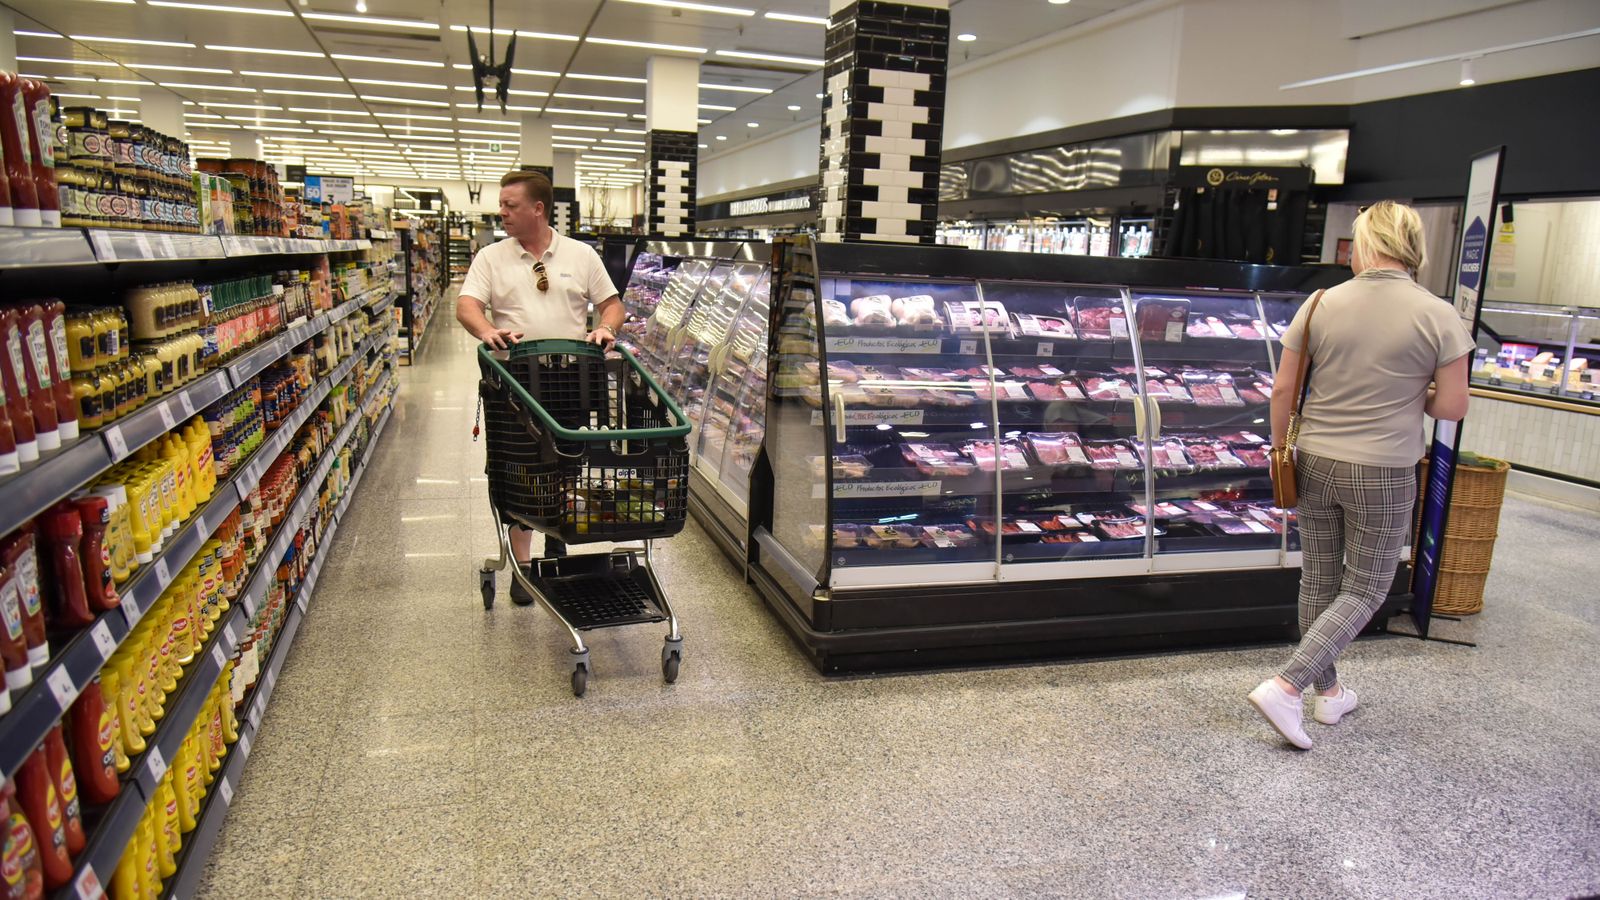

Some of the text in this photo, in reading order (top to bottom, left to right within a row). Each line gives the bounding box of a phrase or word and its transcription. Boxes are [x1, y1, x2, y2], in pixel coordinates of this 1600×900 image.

[857, 340, 885, 348] Productos
[618, 467, 637, 478] alpo
[856, 484, 883, 493] Productos
